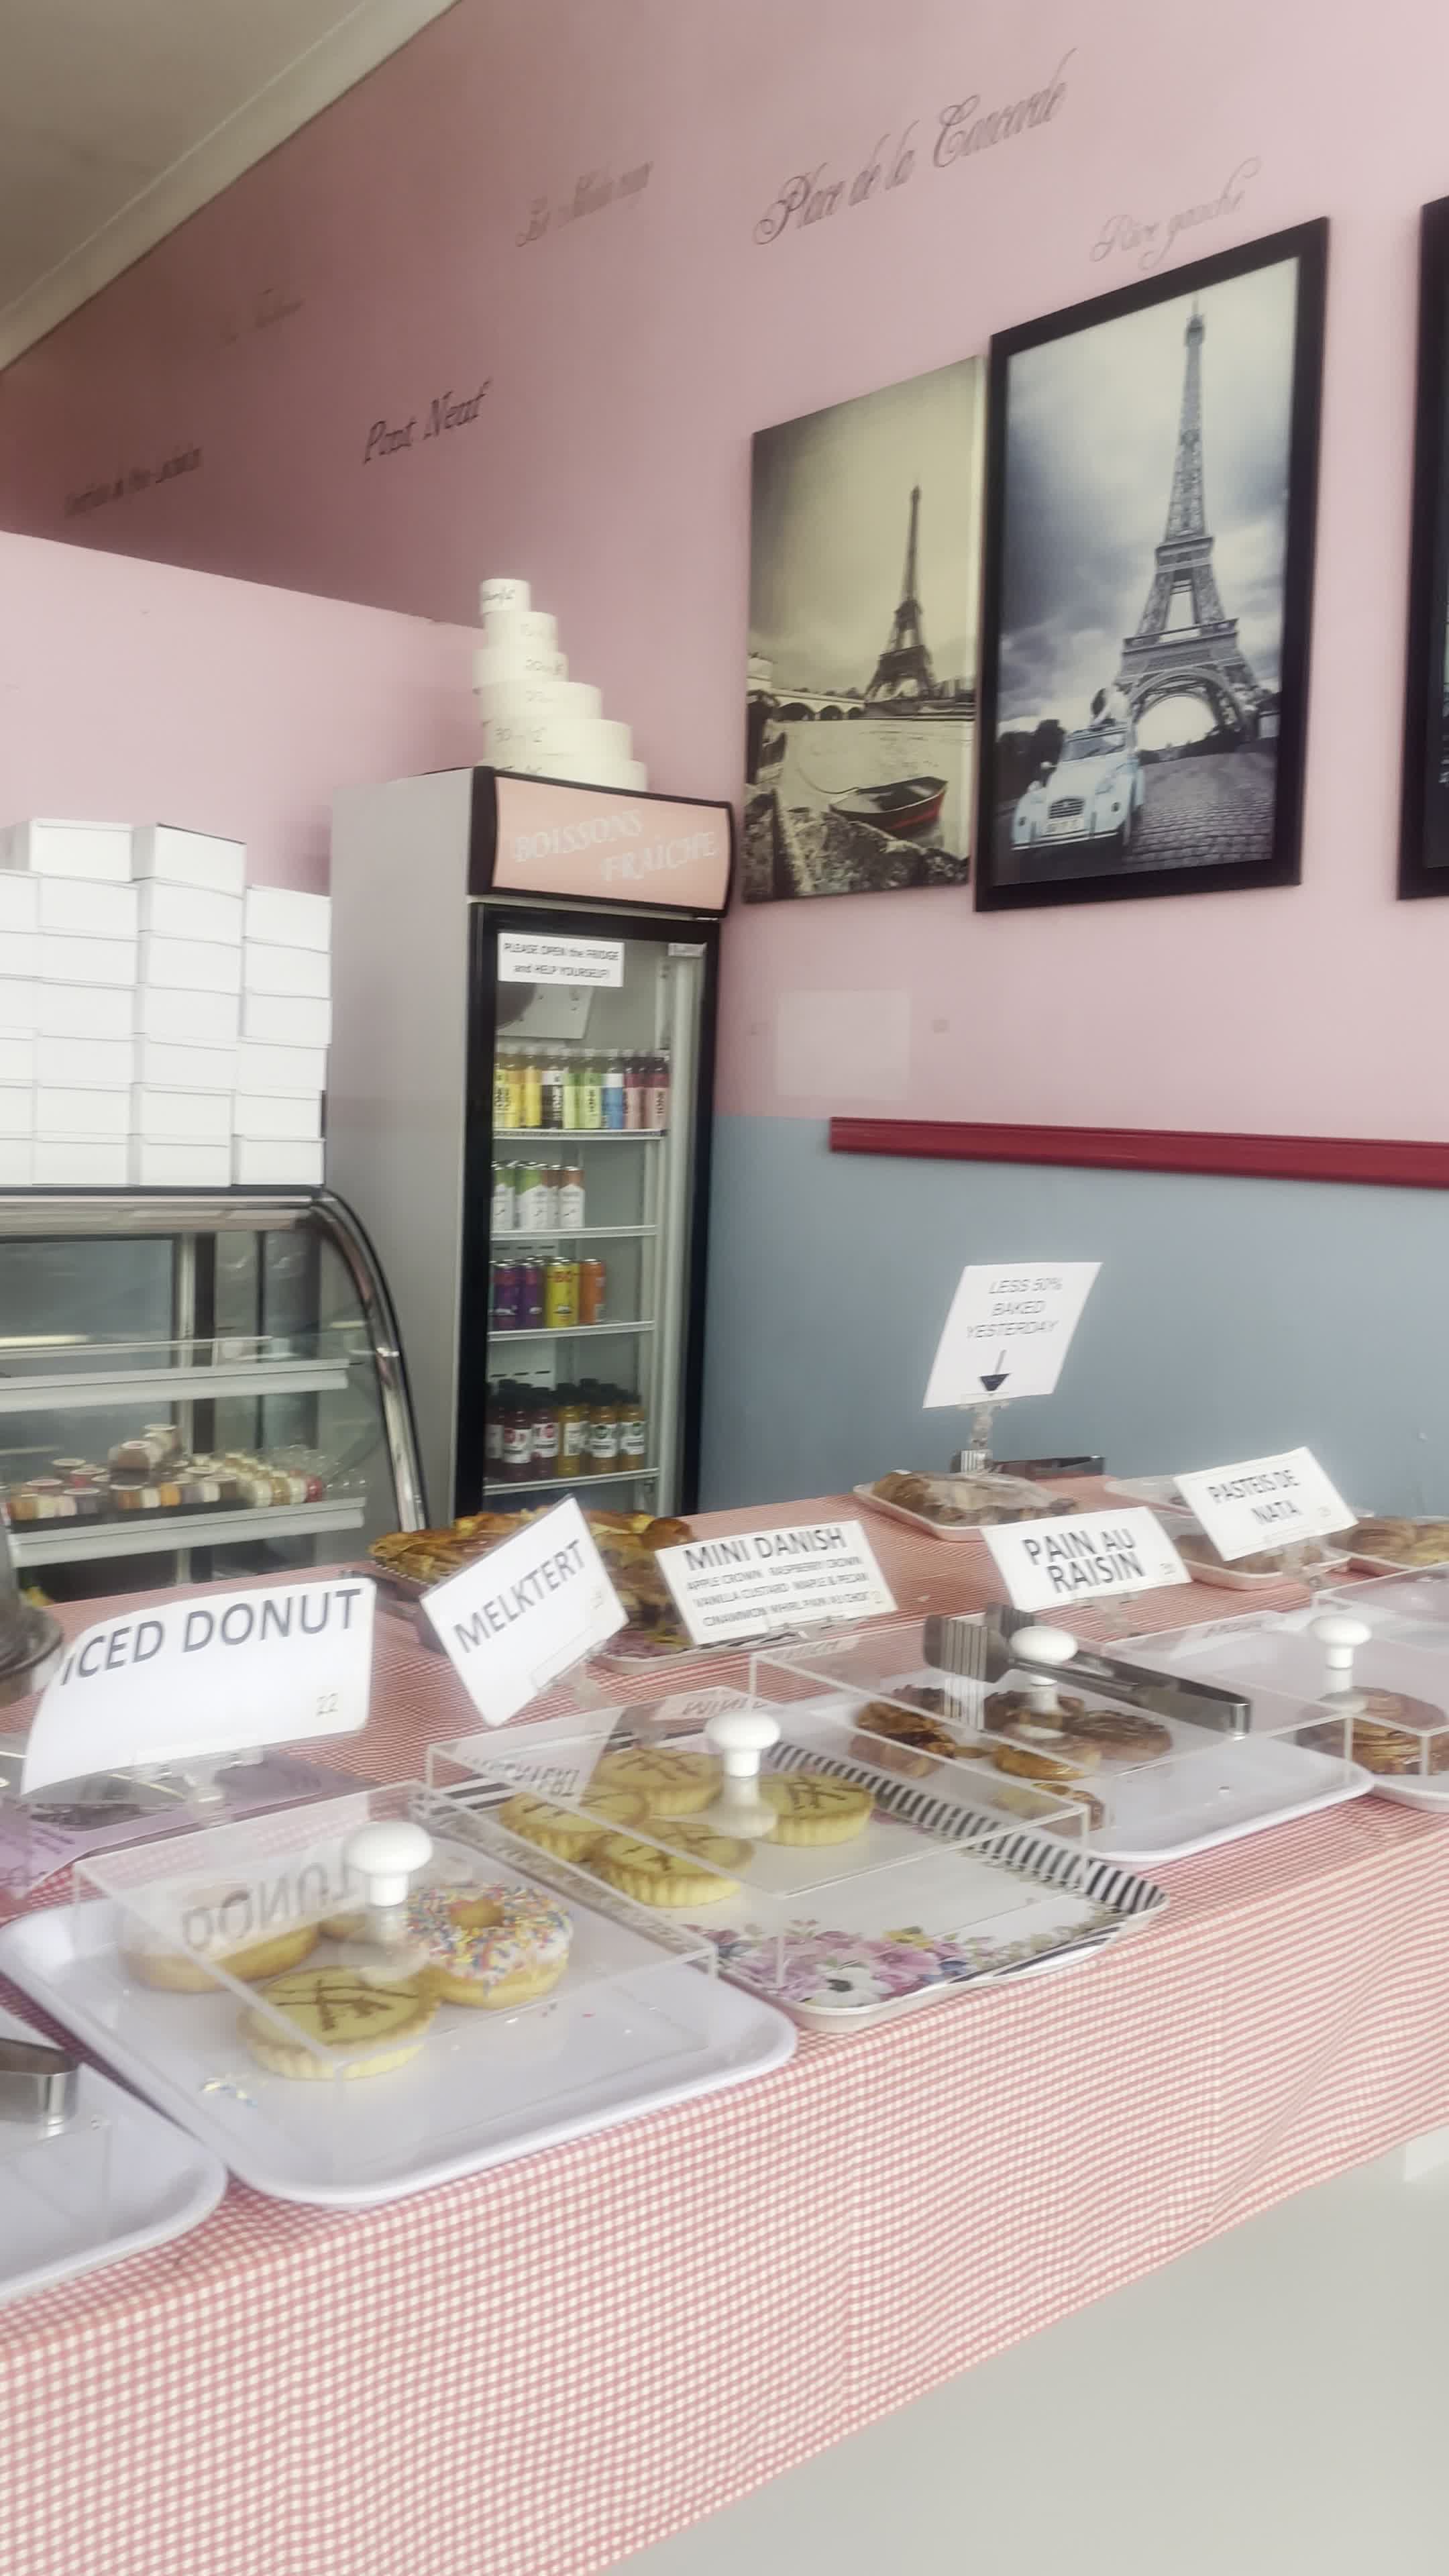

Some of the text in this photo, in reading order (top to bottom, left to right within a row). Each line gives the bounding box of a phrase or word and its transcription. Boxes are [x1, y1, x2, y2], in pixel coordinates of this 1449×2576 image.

[849, 133, 891, 206] de
[885, 119, 920, 191] la
[514, 808, 643, 863] BOISSONS
[504, 943, 620, 961] PLEASE OPEN the FRIDGE
[514, 963, 532, 973] and
[535, 964, 557, 975] HELP
[987, 1278, 1031, 1294] LESS
[991, 1300, 1046, 1316] BAKED
[966, 1320, 1059, 1338] YESTERDAY
[1272, 1469, 1301, 1489] DE
[1250, 1500, 1303, 1524] NATA
[684, 1527, 849, 1571] MINI DANISH
[1022, 1527, 1134, 1565] PAIN AU
[686, 1556, 863, 1591] APPLE CROWN RASPBERRY CROWN
[1046, 1551, 1146, 1593] RAISIN
[453, 1539, 586, 1654] MELKTERT
[693, 1591, 740, 1608] VANILLA
[740, 1582, 790, 1599] CUSTARD
[792, 1576, 828, 1591] MAPLE
[836, 1572, 869, 1585] PECAN
[60, 1589, 362, 1686] ICED DONUT
